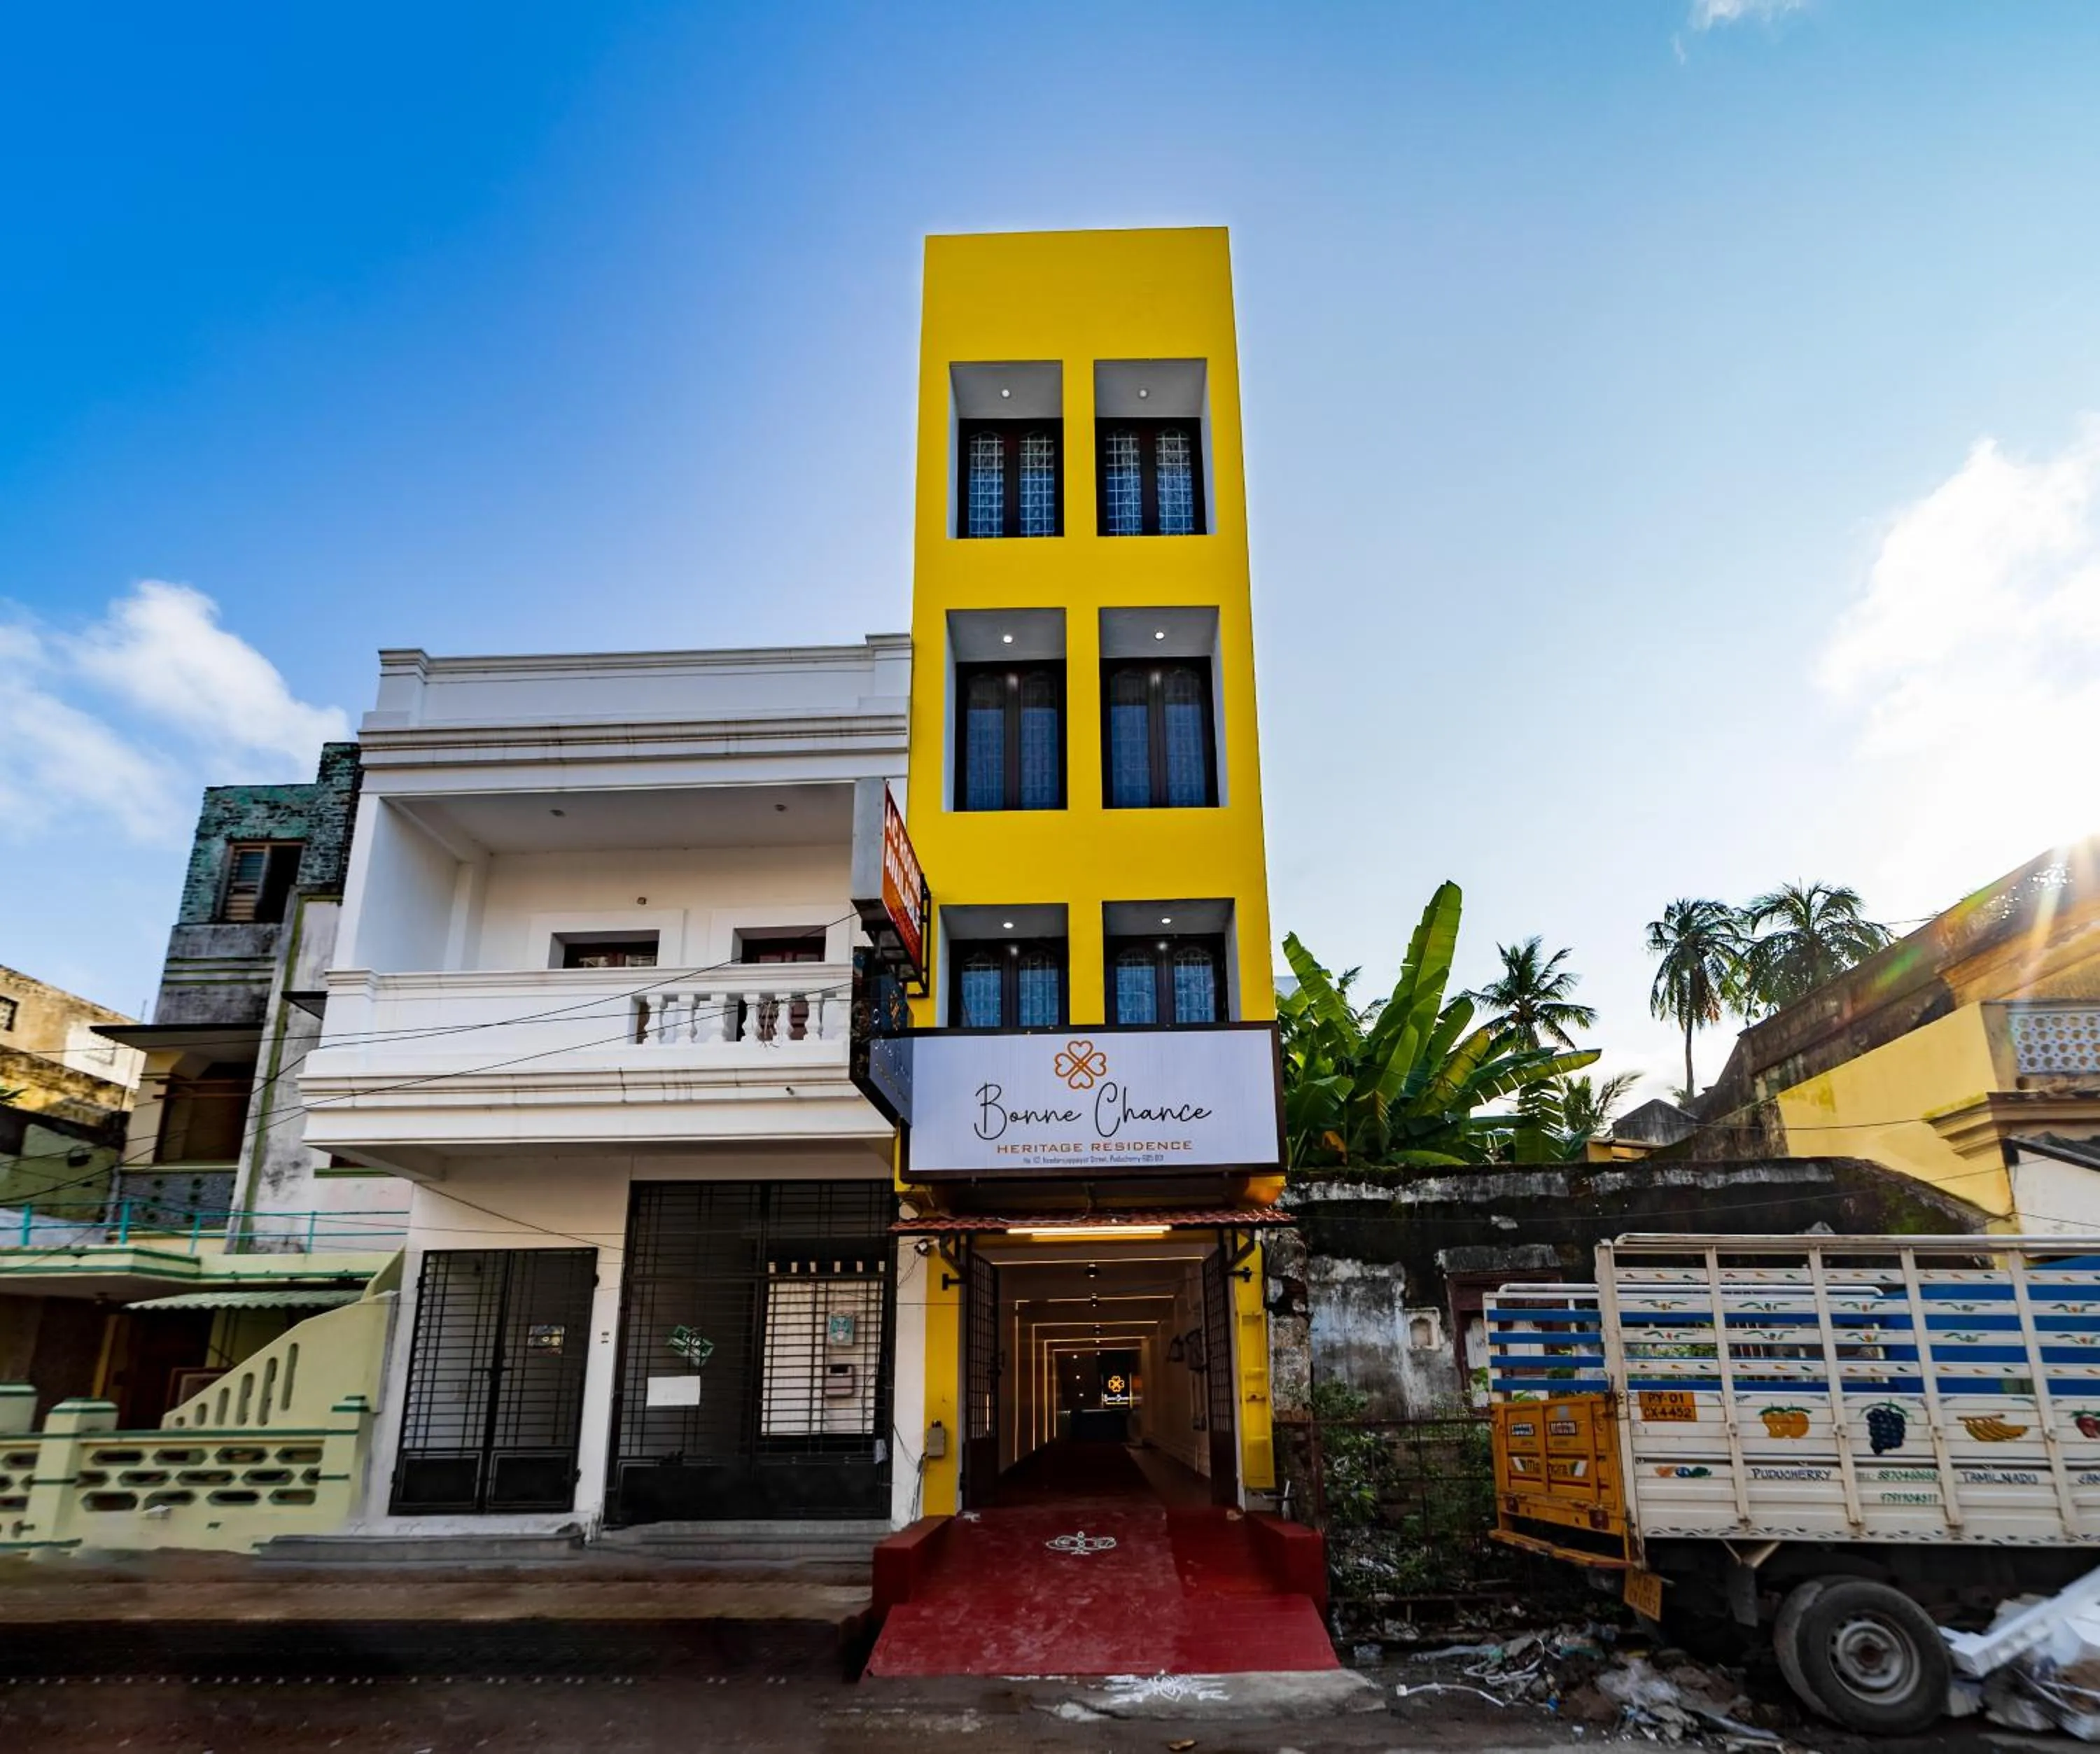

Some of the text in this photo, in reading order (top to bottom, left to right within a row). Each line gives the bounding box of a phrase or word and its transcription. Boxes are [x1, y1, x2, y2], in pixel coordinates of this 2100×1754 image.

[974, 1081, 1212, 1140] Bonne Chance
[997, 1141, 1193, 1154] HERITAGE RESIDENCE
[1751, 1468, 1832, 1481] PUDUCHERRY
